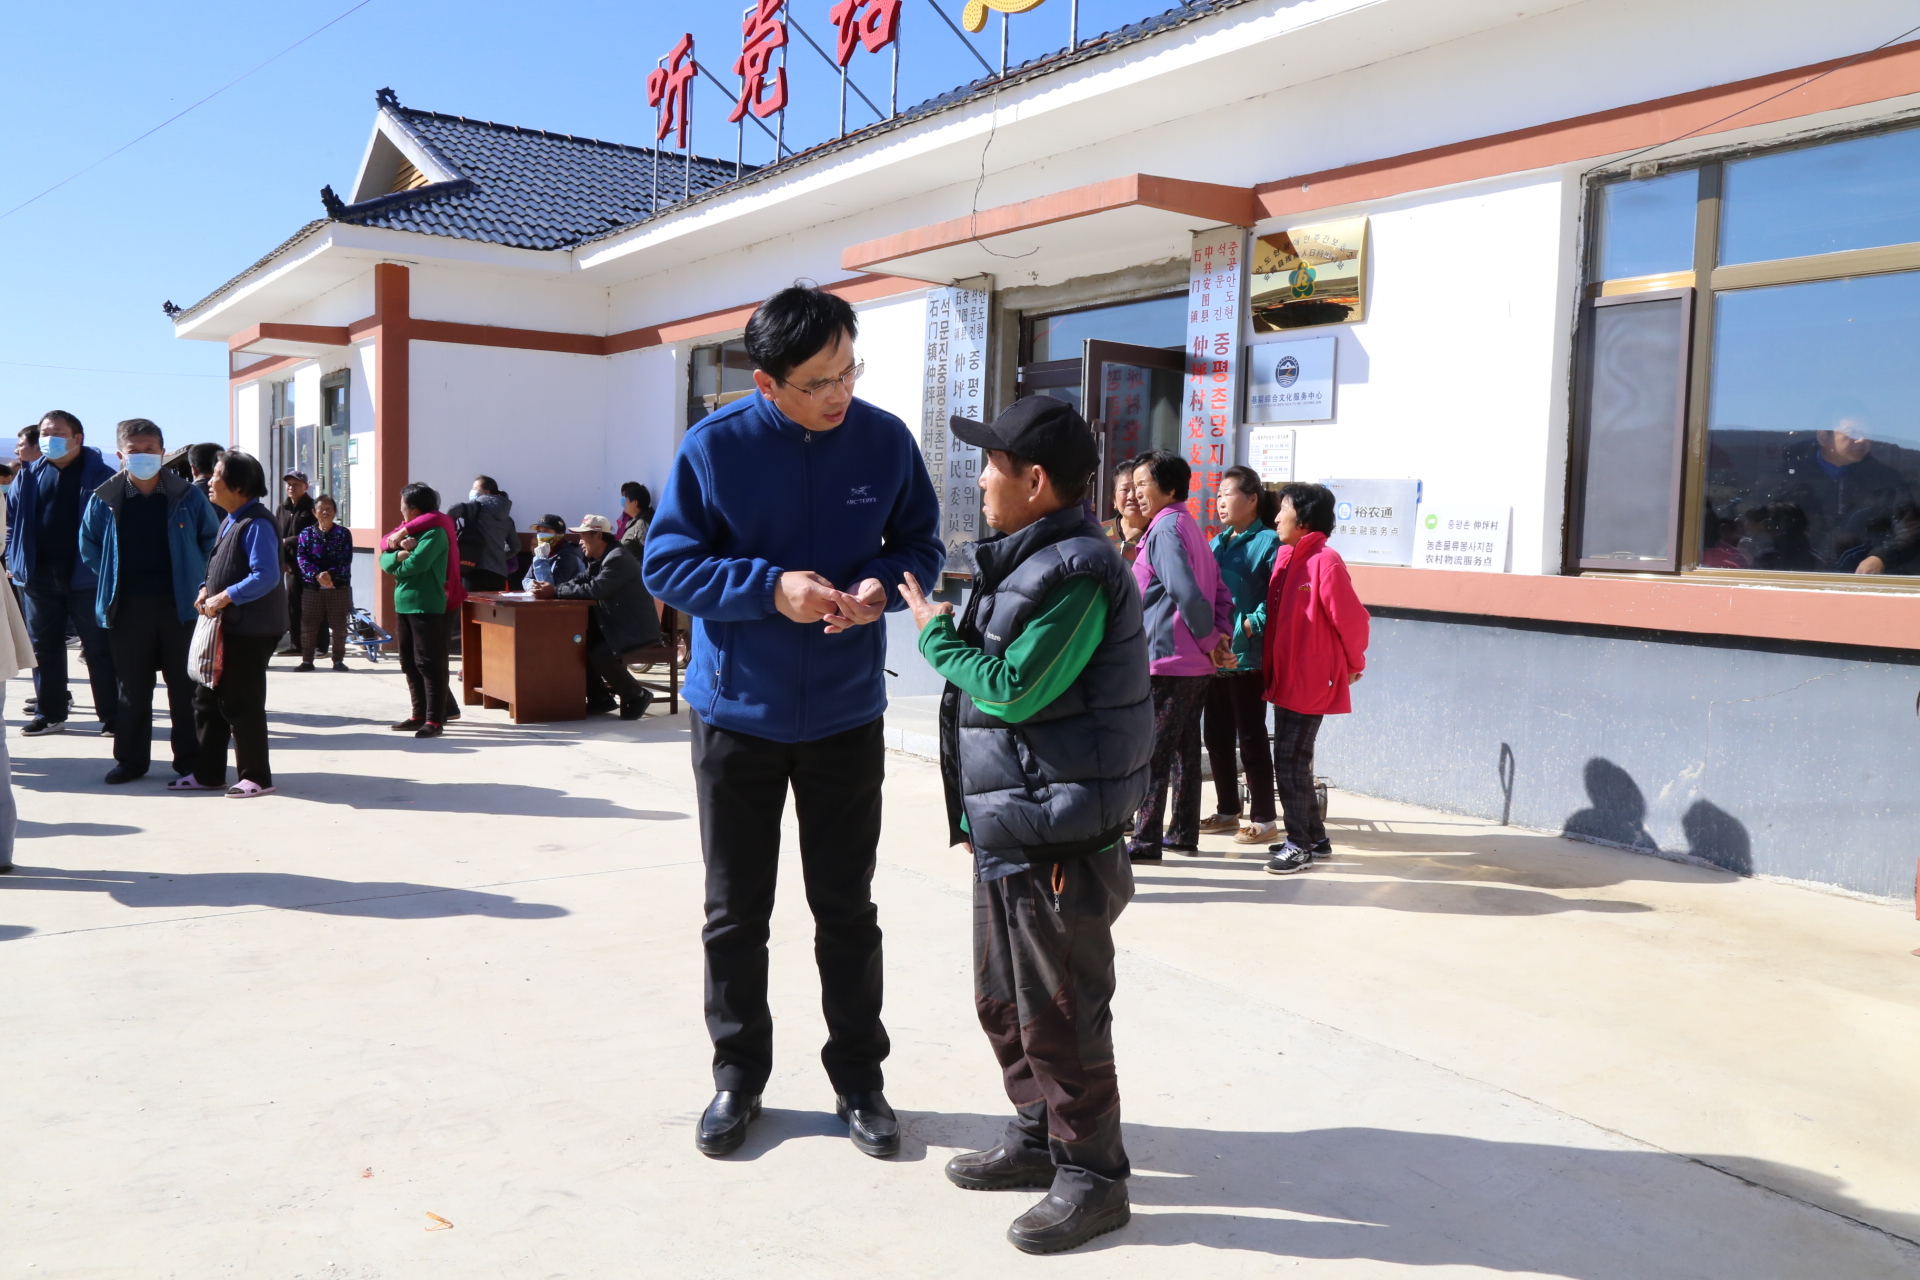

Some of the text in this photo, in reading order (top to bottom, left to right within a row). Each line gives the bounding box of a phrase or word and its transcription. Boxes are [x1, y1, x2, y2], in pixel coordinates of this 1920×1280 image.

[1201, 245, 1214, 323] 中共安图县
[1213, 242, 1226, 321] 석문진
[1224, 241, 1239, 320] 중공안도현
[969, 288, 978, 340] 석문진
[976, 287, 986, 339] 안도현
[1251, 391, 1323, 405] 基层综合文化服务中心
[962, 350, 980, 553] 중평촌민위원
[1355, 506, 1393, 518] 裕农通
[1448, 520, 1499, 531] 중평촌 仲坪村
[1425, 554, 1492, 567] 农村物流服务点
[1426, 540, 1494, 553] 농촌물류봉사지점
